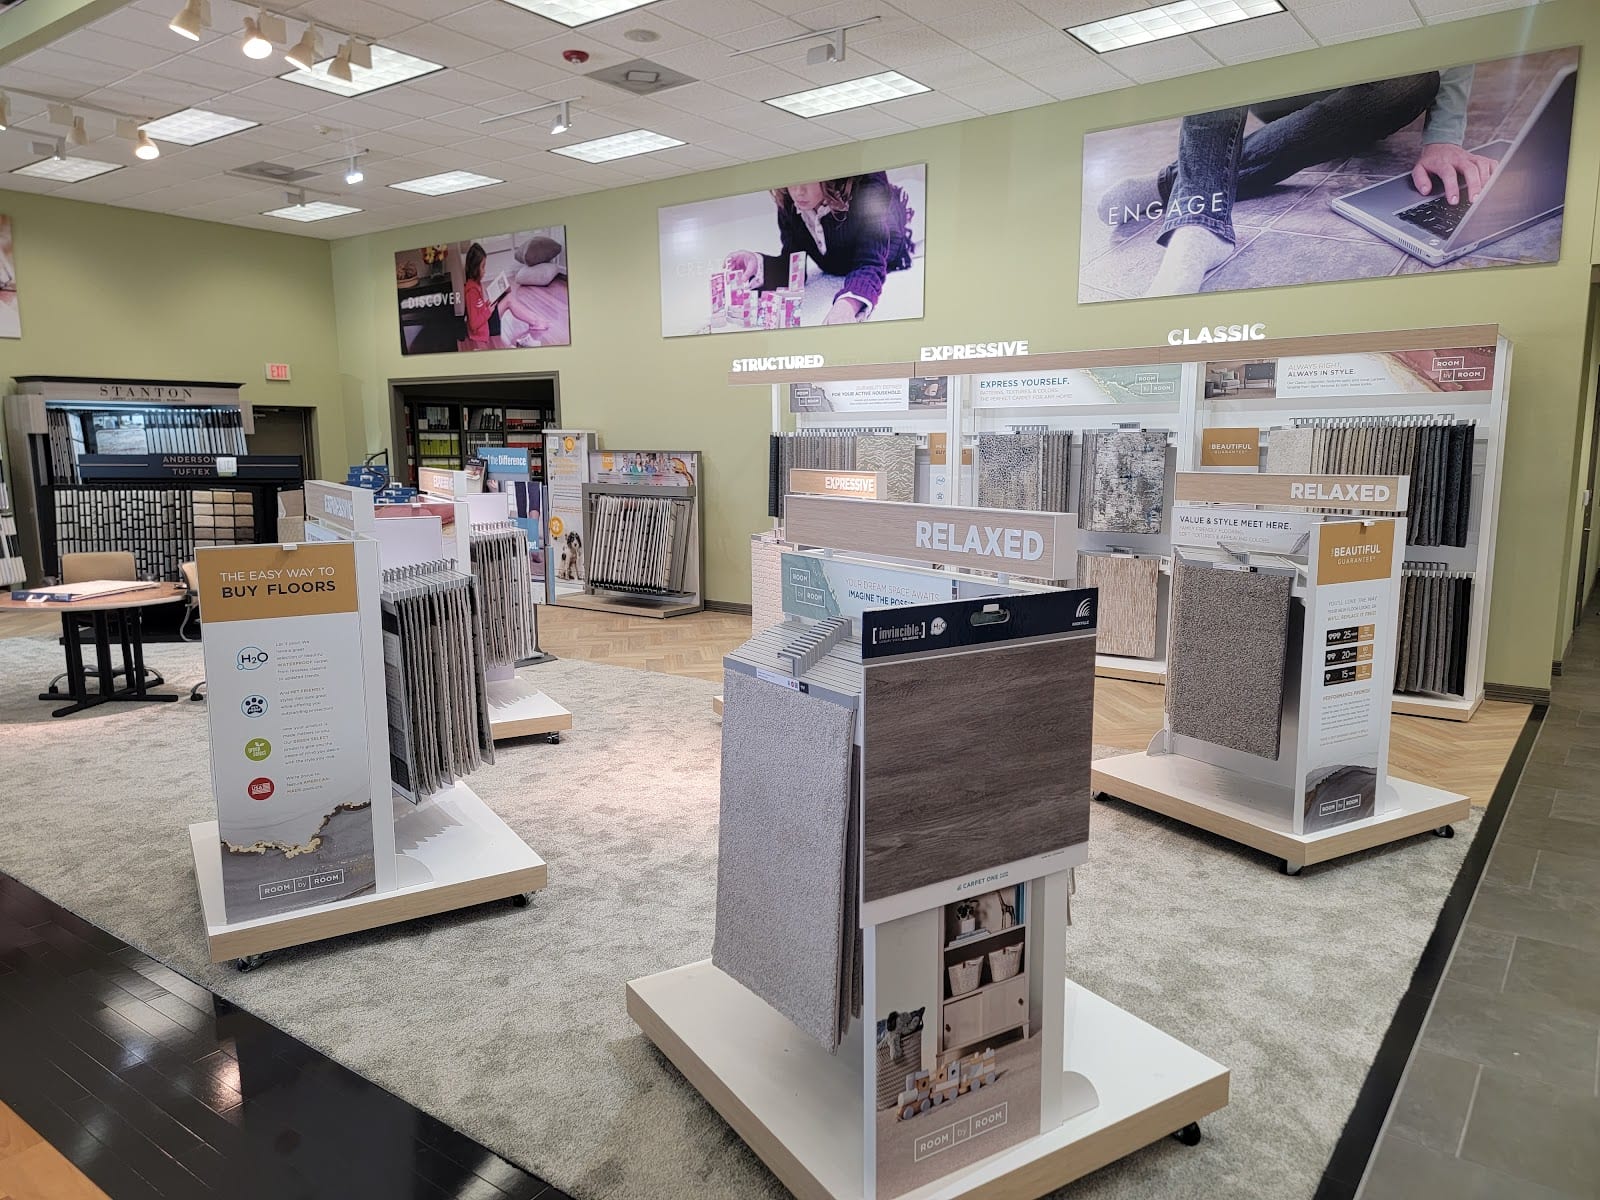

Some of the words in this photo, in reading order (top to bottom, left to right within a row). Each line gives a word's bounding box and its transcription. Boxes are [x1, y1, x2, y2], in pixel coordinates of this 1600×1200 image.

[1107, 192, 1224, 226] ENGAGE
[406, 291, 461, 309] DISCOVER
[1167, 323, 1266, 346] CLASSIC
[920, 340, 1029, 362] EXPRESSIVE
[732, 354, 824, 373] STRUCTURED
[1288, 363, 1317, 371] ALWAYS
[271, 365, 288, 378] EXIT
[980, 380, 1019, 388] EXPRESS
[1021, 377, 1070, 387] YOURSELF.
[99, 385, 193, 398] STANTON
[498, 454, 527, 466] Difference
[172, 468, 210, 476] TUFTEX
[825, 476, 875, 492] EXPRESSIVE
[1290, 482, 1390, 502] RELAXED
[1179, 515, 1204, 524] VALUE
[1206, 517, 1212, 525] &
[1213, 518, 1238, 527] STYLE
[1240, 519, 1263, 528] MEET
[1265, 521, 1292, 530] HERE.
[916, 520, 1044, 561] RELAXED
[1334, 544, 1381, 557] BEAUTIFUL
[219, 571, 245, 582] THE
[249, 570, 284, 581] EASY
[286, 568, 315, 578] WAY
[318, 566, 335, 576] TO
[792, 572, 808, 582] ROOM
[221, 585, 258, 599] BUY
[267, 580, 336, 596] FLOORS
[807, 592, 823, 602] ROOM
[846, 577, 862, 590] YOUR
[863, 580, 887, 592] DREAM
[889, 585, 910, 597] SPACE
[911, 590, 940, 602] AWAITS
[848, 590, 875, 602] IMAGINE
[875, 594, 889, 605] THE
[1343, 630, 1352, 639] 25
[1341, 650, 1351, 660] 20
[1341, 670, 1349, 678] 15
[264, 884, 290, 894] ROOM
[298, 880, 307, 889] by
[314, 875, 339, 885] ROOM
[962, 877, 986, 889] CARPET
[986, 874, 999, 882] ONE
[920, 1132, 949, 1153] ROOM
[957, 1124, 967, 1138] by
[974, 1111, 1003, 1129] ROOM
